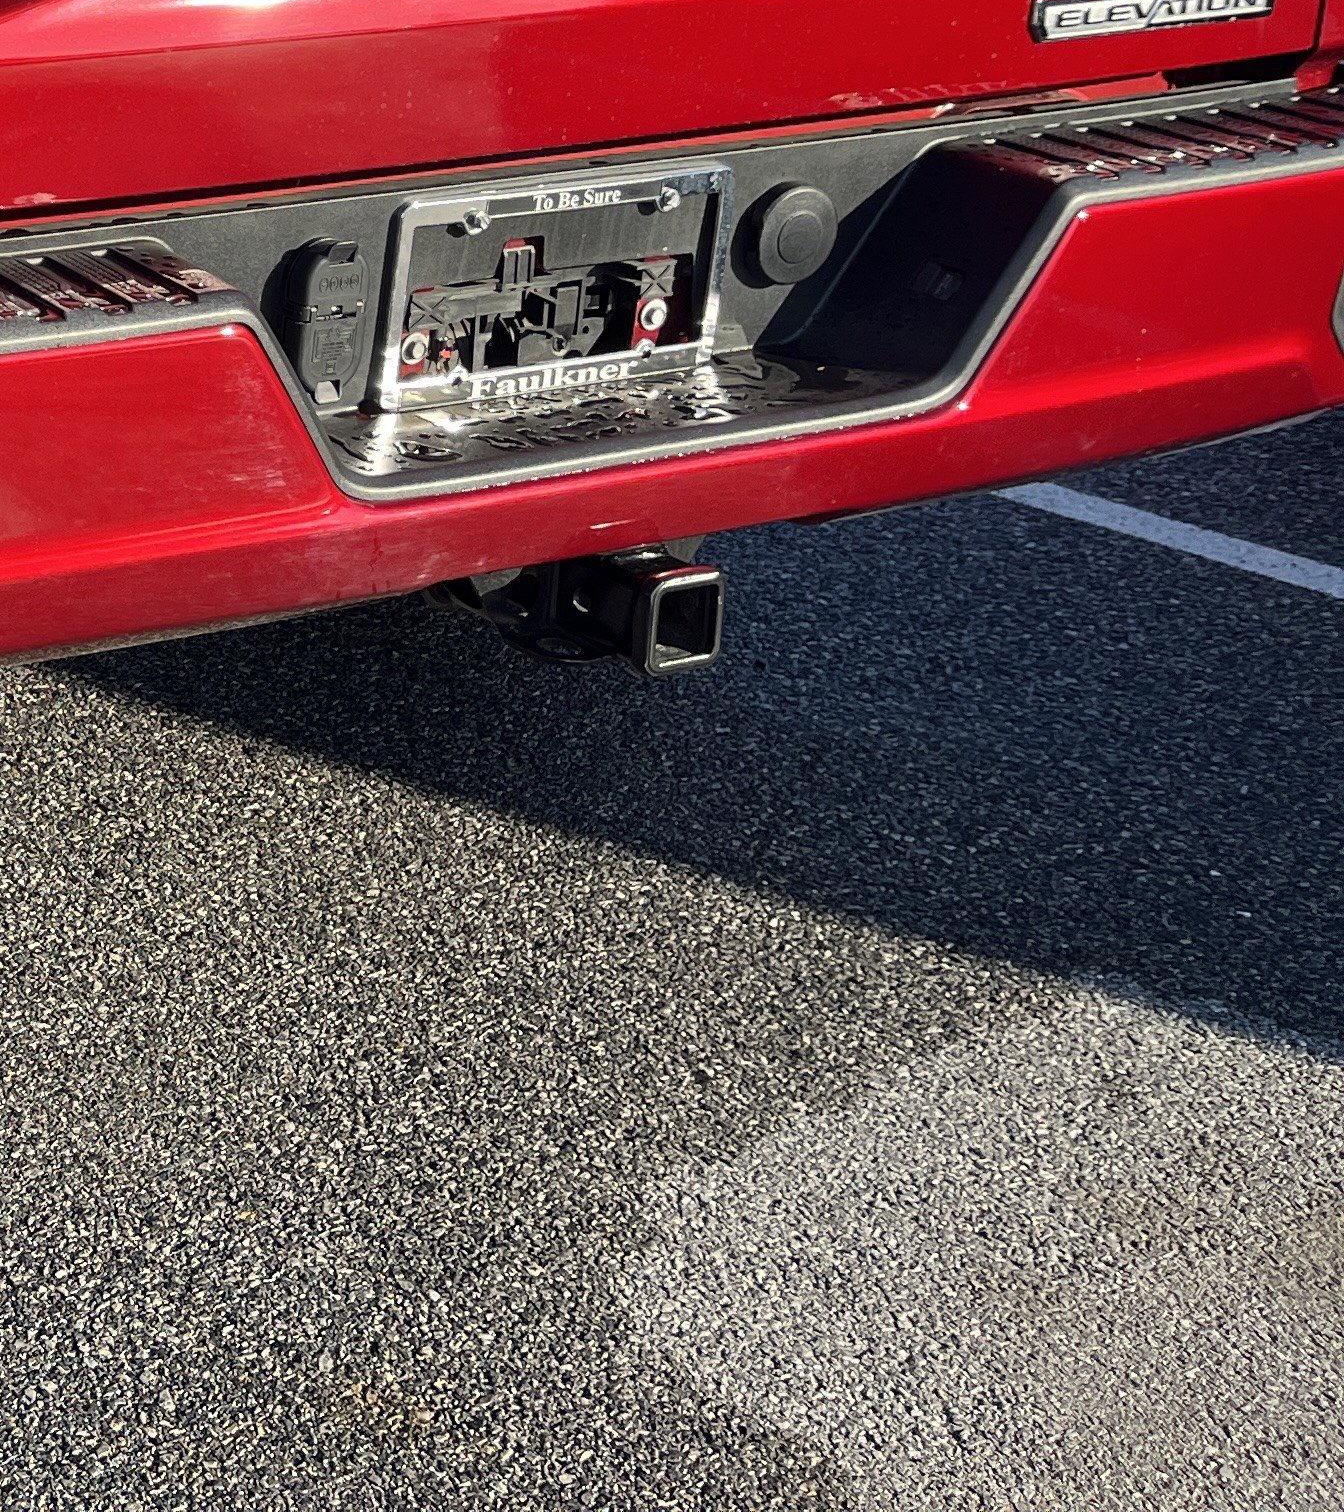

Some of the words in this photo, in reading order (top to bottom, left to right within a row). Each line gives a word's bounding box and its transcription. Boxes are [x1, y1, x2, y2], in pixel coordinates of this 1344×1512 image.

[532, 194, 554, 212] To
[557, 191, 580, 209] Be
[582, 187, 622, 207] Sure
[467, 360, 639, 402] Faulkner
